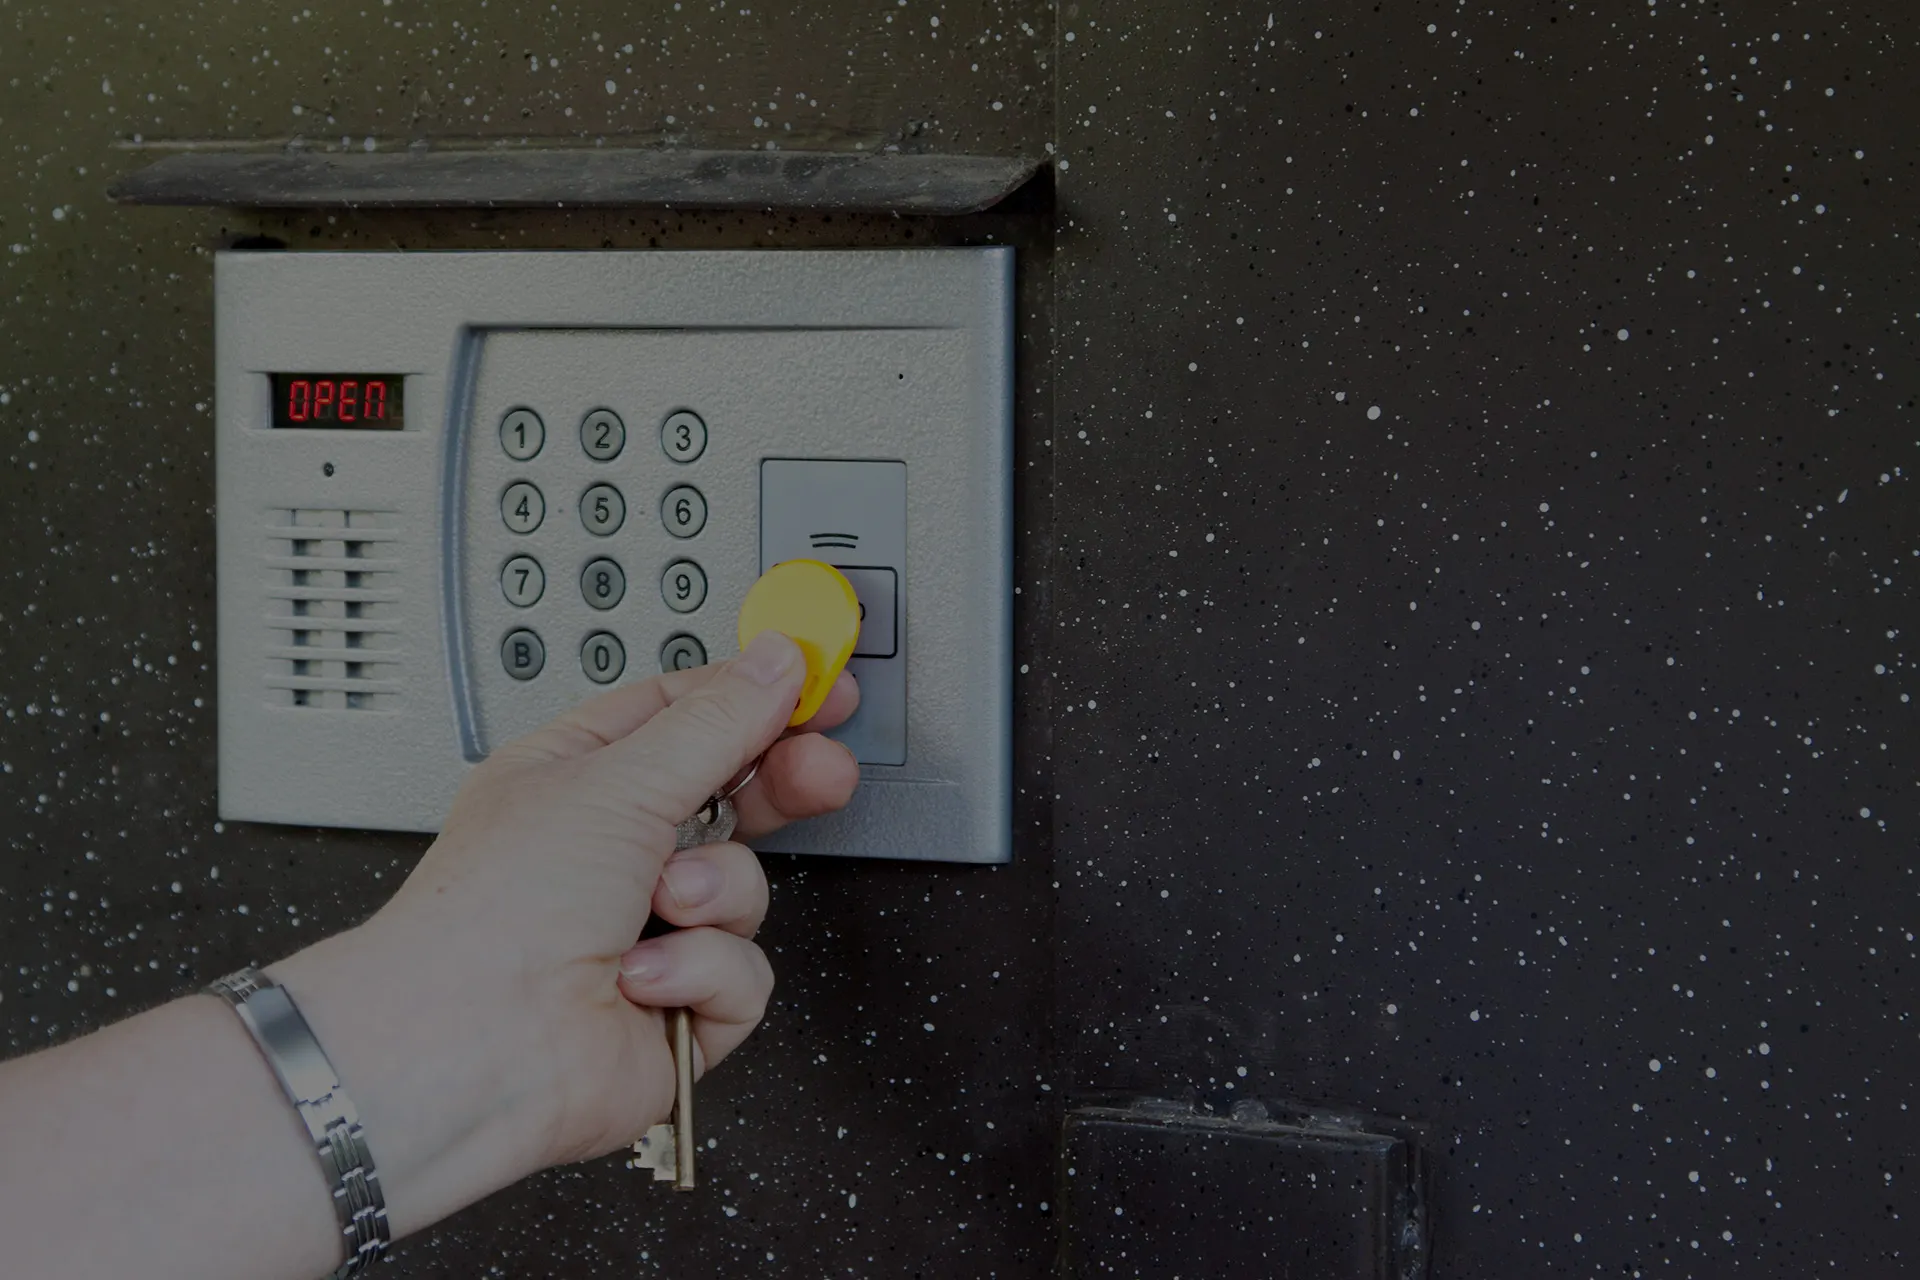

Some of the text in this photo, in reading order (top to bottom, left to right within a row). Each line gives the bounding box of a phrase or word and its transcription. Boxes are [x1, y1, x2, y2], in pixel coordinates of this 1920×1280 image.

[594, 421, 610, 449] 2
[675, 424, 692, 451] 3
[515, 495, 692, 526] 4 5 6
[515, 569, 692, 600] 7 8 9
[515, 643, 531, 668] B
